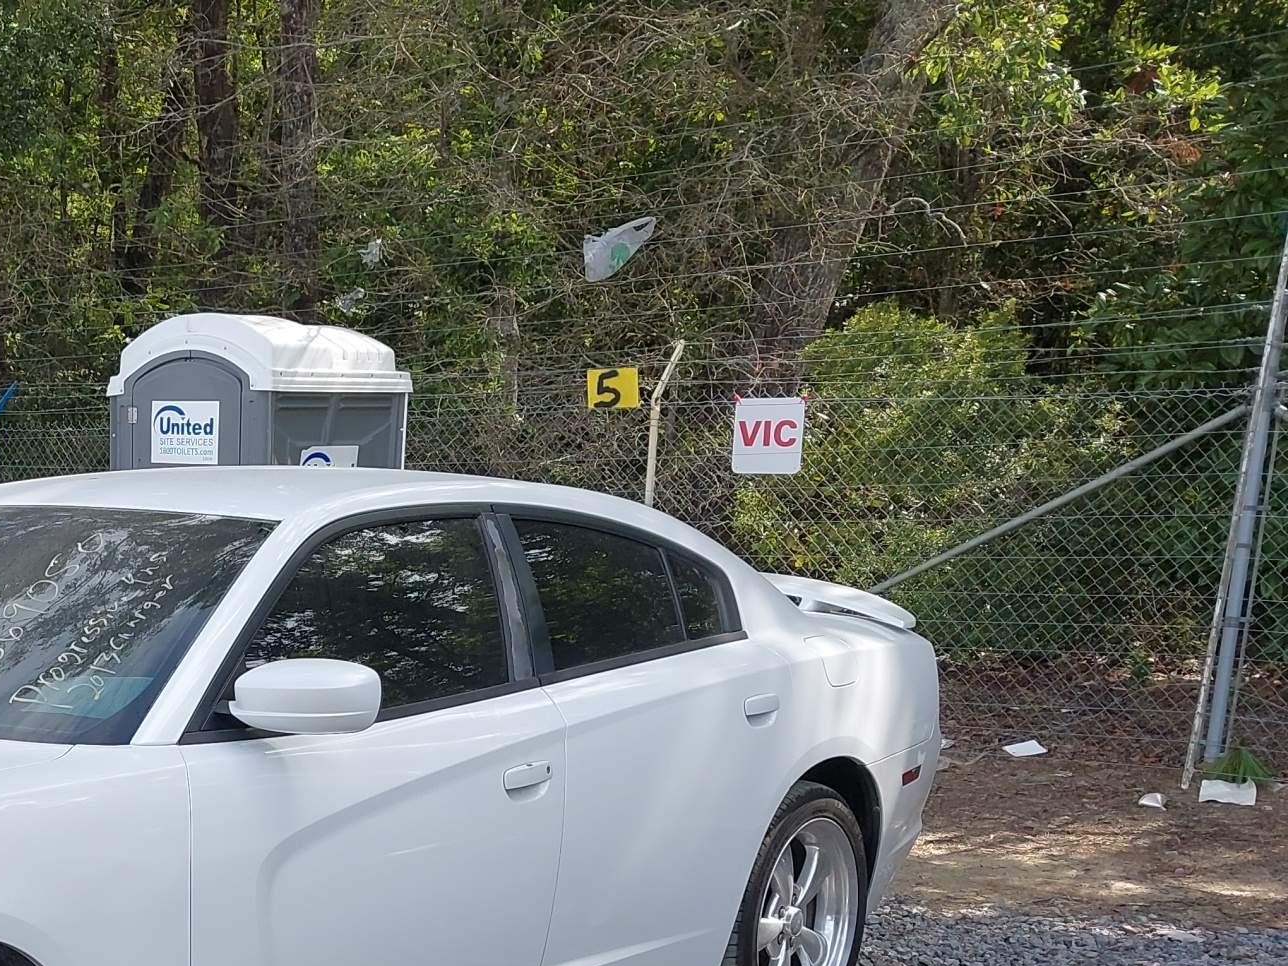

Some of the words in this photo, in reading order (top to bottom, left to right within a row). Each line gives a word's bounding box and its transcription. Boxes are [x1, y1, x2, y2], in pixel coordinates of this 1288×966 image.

[594, 370, 621, 408] 5
[159, 416, 214, 436] United
[738, 419, 798, 448] VIC
[159, 438, 174, 446] SITE
[176, 438, 214, 447] SERVICES
